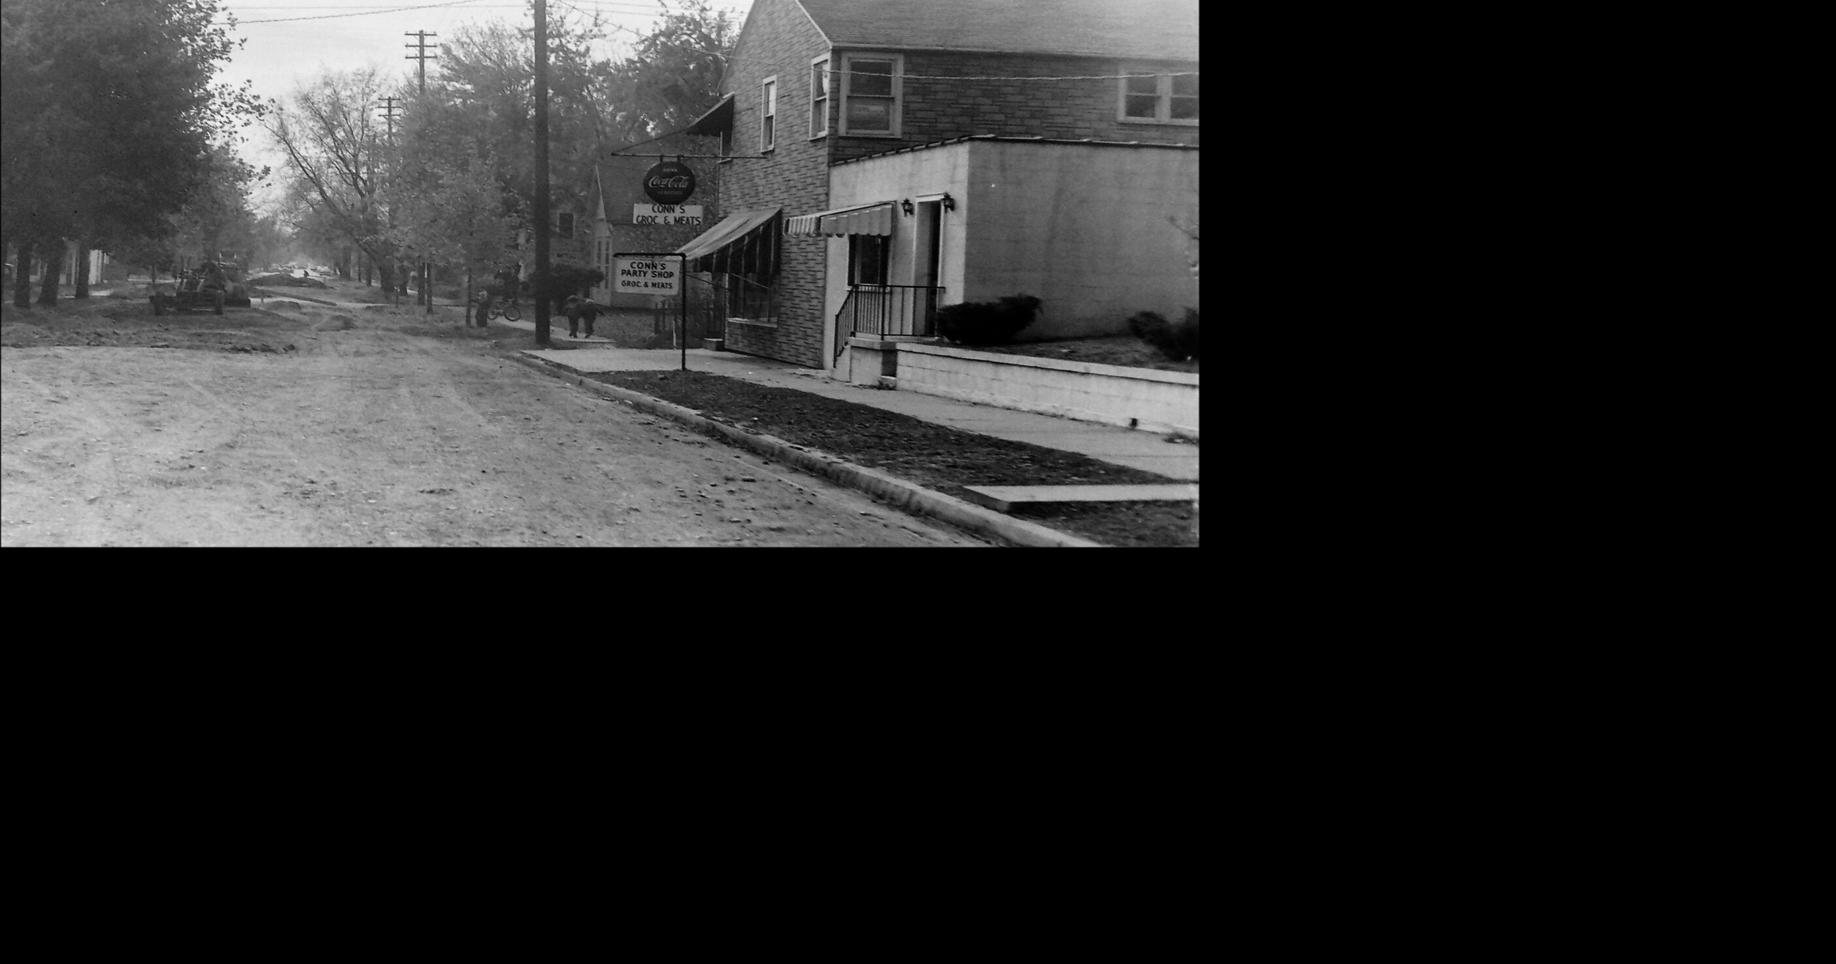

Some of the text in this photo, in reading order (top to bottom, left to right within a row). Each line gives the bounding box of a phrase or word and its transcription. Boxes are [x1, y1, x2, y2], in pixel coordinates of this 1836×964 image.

[664, 215, 671, 225] &
[674, 216, 701, 225] MEATS
[621, 269, 674, 278] PARTY SHOP
